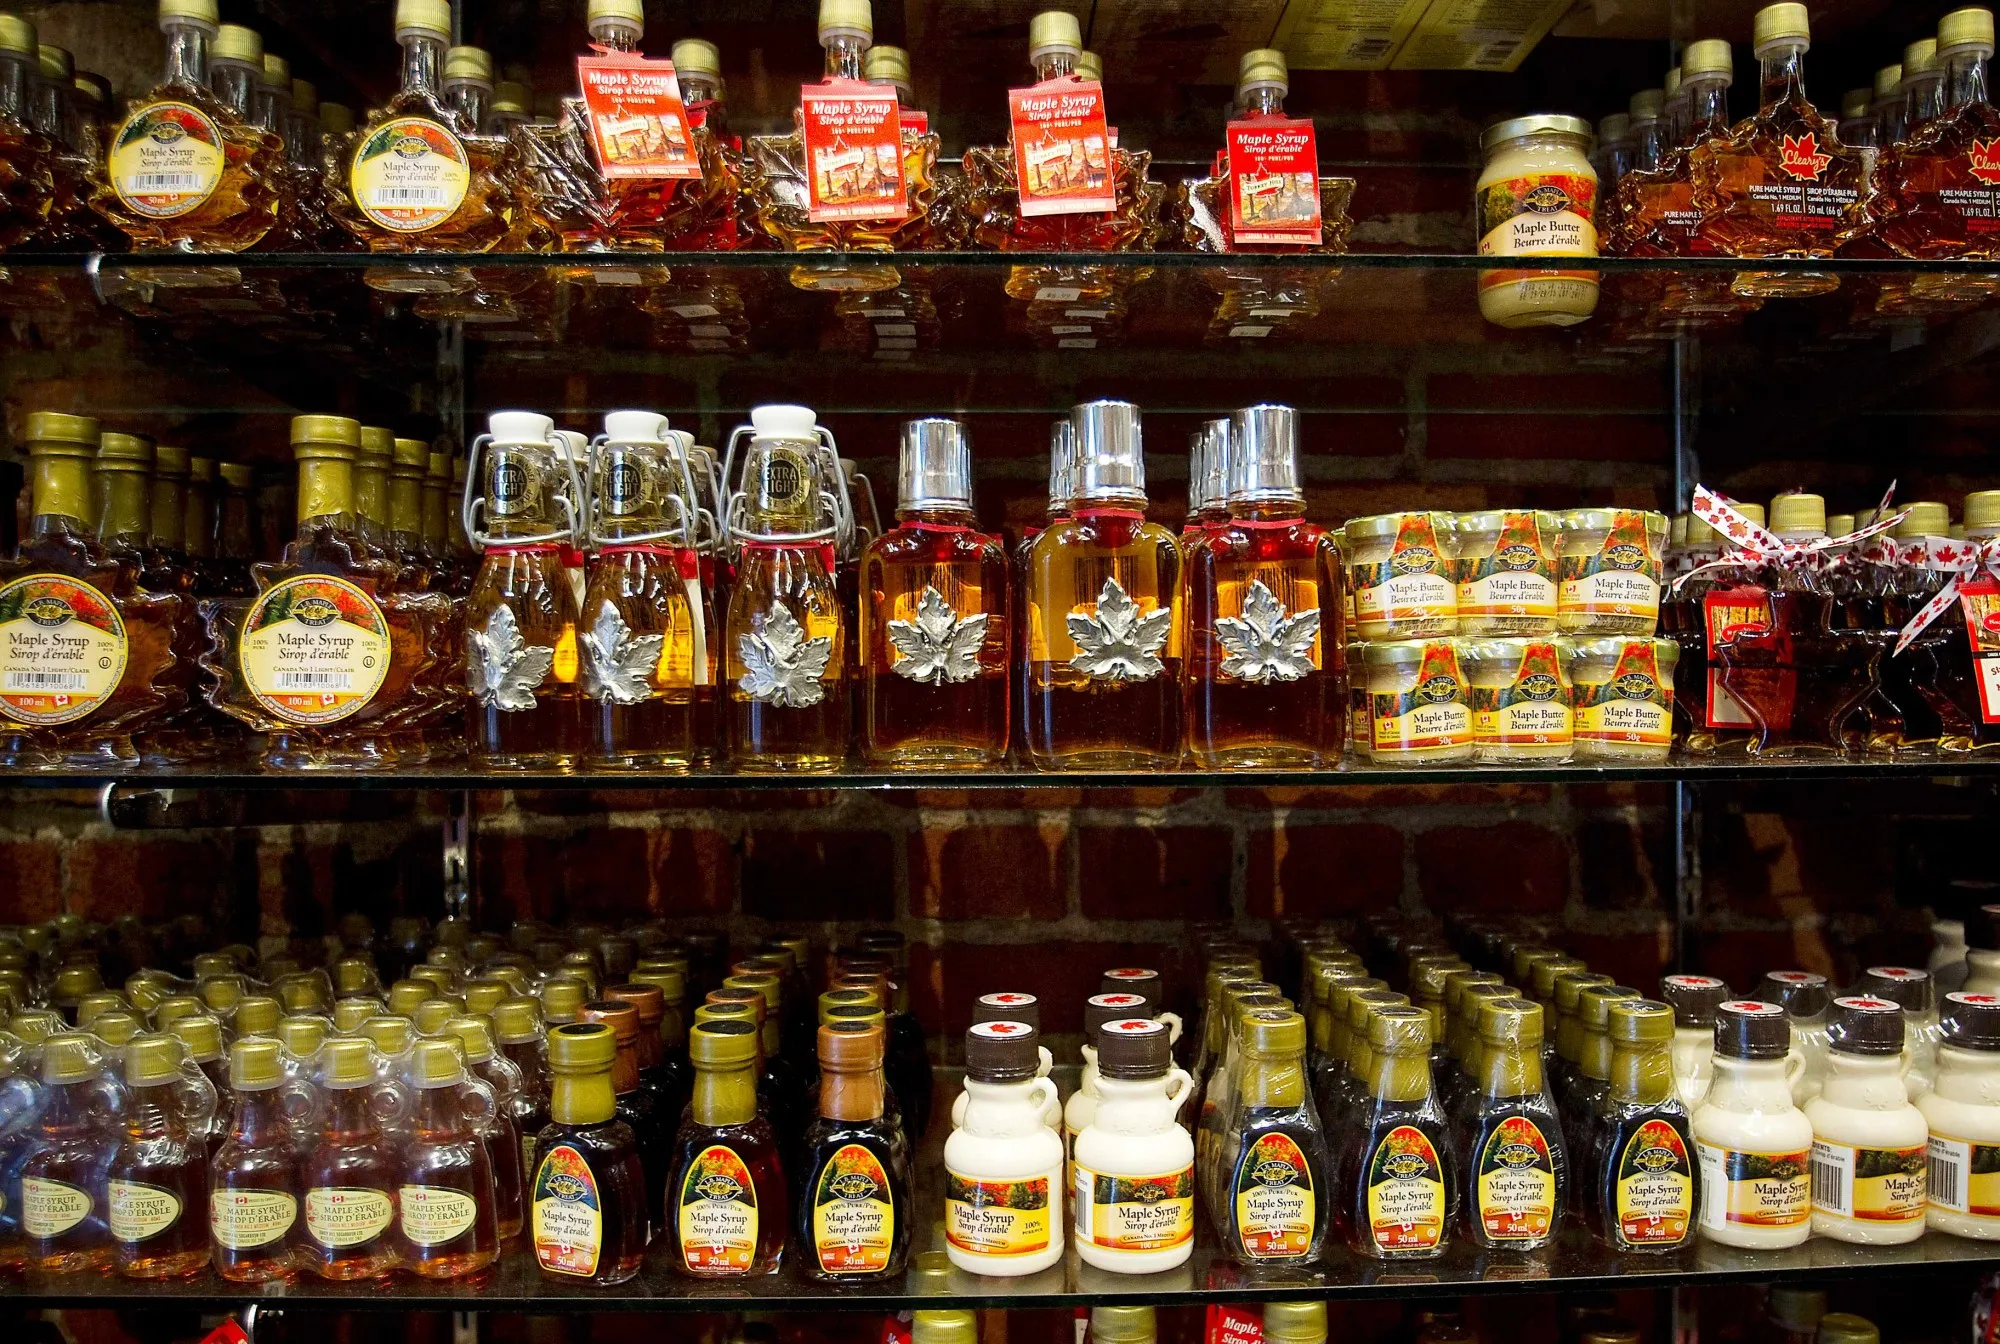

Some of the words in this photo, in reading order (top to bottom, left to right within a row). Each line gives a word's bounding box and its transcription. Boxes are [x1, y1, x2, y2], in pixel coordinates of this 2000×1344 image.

[588, 72, 628, 86] Maple
[632, 73, 668, 88] Syrup
[598, 86, 624, 96] Sirop
[626, 86, 664, 96] d'érable
[812, 102, 851, 116] Maple
[854, 102, 891, 116] Syrup
[1020, 97, 1058, 112] Maple
[1062, 94, 1096, 110] Syrup
[820, 116, 844, 126] Sirop
[848, 114, 884, 124] d'érable
[1028, 111, 1052, 122] Sirop
[1054, 108, 1090, 119] d'érable
[1237, 134, 1272, 145] Maple
[1276, 134, 1308, 145] Syrup
[140, 146, 166, 160] Maple
[168, 146, 195, 160] Syrup
[1244, 145, 1266, 154] Sirop
[1269, 144, 1302, 153] d'érable
[142, 158, 160, 169] Sirop
[164, 158, 192, 166] d'érable
[1785, 150, 1827, 172] Cleary's
[383, 162, 410, 174] Maple
[412, 162, 440, 174] Syrup
[384, 174, 406, 184] Sirop
[407, 172, 437, 182] d'érable
[1247, 182, 1268, 190] TURKEY
[1543, 186, 1564, 197] MAPLE
[1784, 186, 1802, 194] SYRUP
[1772, 204, 1784, 212] 1.69
[1808, 205, 1816, 214] 50
[1826, 206, 1836, 216] (66
[1962, 207, 1974, 216] 1.69
[1514, 222, 1547, 236] Maple
[1550, 220, 1580, 233] Butter
[1514, 237, 1546, 248] Beurre
[1548, 234, 1581, 246] d'érable
[766, 467, 797, 480] EXTRA
[767, 480, 798, 493] LIGHT
[1490, 580, 1518, 592] Maple
[1520, 580, 1545, 590] Butter
[1594, 578, 1624, 590] Maple
[1626, 579, 1650, 590] Butter
[1490, 592, 1517, 600] Beurre
[1519, 590, 1545, 600] d'érable
[1594, 590, 1622, 599] Beurre
[1624, 590, 1650, 601] d'érable
[9, 632, 49, 648] Maple
[52, 633, 90, 648] Syrup
[278, 633, 316, 648] Maple
[318, 634, 354, 648] Syrup
[10, 648, 40, 662] Sirop
[42, 648, 84, 660] d'érable
[279, 648, 308, 662] Sirop
[310, 648, 349, 660] d'érable
[19, 697, 34, 706] 100
[35, 698, 45, 706] ml
[288, 697, 302, 706] 100
[303, 698, 312, 706] ml
[1414, 712, 1442, 726] Maple
[1444, 710, 1466, 722] Butter
[1510, 710, 1540, 722] Maple
[1542, 710, 1564, 719] Butter
[1604, 706, 1634, 720] Maple
[1636, 708, 1660, 719] Butter
[1415, 722, 1442, 734] Beurre
[1444, 720, 1466, 731] d'érable
[1511, 721, 1538, 730] Beurre
[1540, 718, 1564, 729] d'érable
[1604, 718, 1632, 728] Beurre
[1634, 719, 1660, 729] d'érable
[1626, 733, 1640, 742] 50g
[1488, 1181, 1517, 1192] Maple
[1518, 1180, 1545, 1192] Syrup
[1628, 1186, 1656, 1198] Maple
[1657, 1184, 1683, 1196] Syrup
[1754, 1182, 1787, 1197] Maple
[1789, 1182, 1808, 1192] Syrup
[1885, 1178, 1914, 1192] Maple
[1378, 1192, 1406, 1204] Maple
[1408, 1190, 1434, 1203] Syrup
[1491, 1193, 1512, 1203] Sirop
[1514, 1190, 1543, 1201] d'érable
[1630, 1198, 1651, 1207] Sirop
[1652, 1196, 1681, 1206] d'érable
[1760, 1196, 1783, 1207] Sirop
[1891, 1192, 1910, 1202] Sirop
[227, 1207, 256, 1217] MAPLE
[257, 1203, 287, 1215] SYRUP
[409, 1203, 434, 1213] MAPLE
[436, 1202, 465, 1214] SYRUP
[1247, 1199, 1276, 1212] Maple
[1277, 1198, 1304, 1210] Syrup
[1381, 1205, 1402, 1214] Sirop
[1403, 1202, 1432, 1212] d'érable
[224, 1214, 247, 1224] SIROP
[408, 1210, 428, 1220] SIROP
[542, 1209, 567, 1223] Maple
[568, 1214, 592, 1227] Syrup
[690, 1212, 719, 1224] Maple
[720, 1213, 748, 1226] Syrup
[826, 1212, 854, 1224] Maple
[856, 1212, 884, 1224] Syrup
[954, 1204, 980, 1223] Maple
[982, 1212, 1014, 1226] Syrup
[1119, 1206, 1153, 1222] Maple
[1155, 1206, 1181, 1220] Syrup
[1250, 1212, 1270, 1222] Sirop
[1272, 1209, 1302, 1220] d'érable
[544, 1222, 562, 1235] Sirop
[564, 1224, 590, 1237] d'érable
[692, 1225, 714, 1236] Sirop
[716, 1224, 746, 1234] d'érable
[828, 1224, 850, 1236] Sirop
[850, 1223, 882, 1234] d'érable
[958, 1218, 976, 1234] Sirop
[978, 1222, 1008, 1234] d'érable
[1125, 1220, 1148, 1232] Sirop
[1149, 1216, 1176, 1230] d'érable
[1222, 1316, 1258, 1335] Maple
